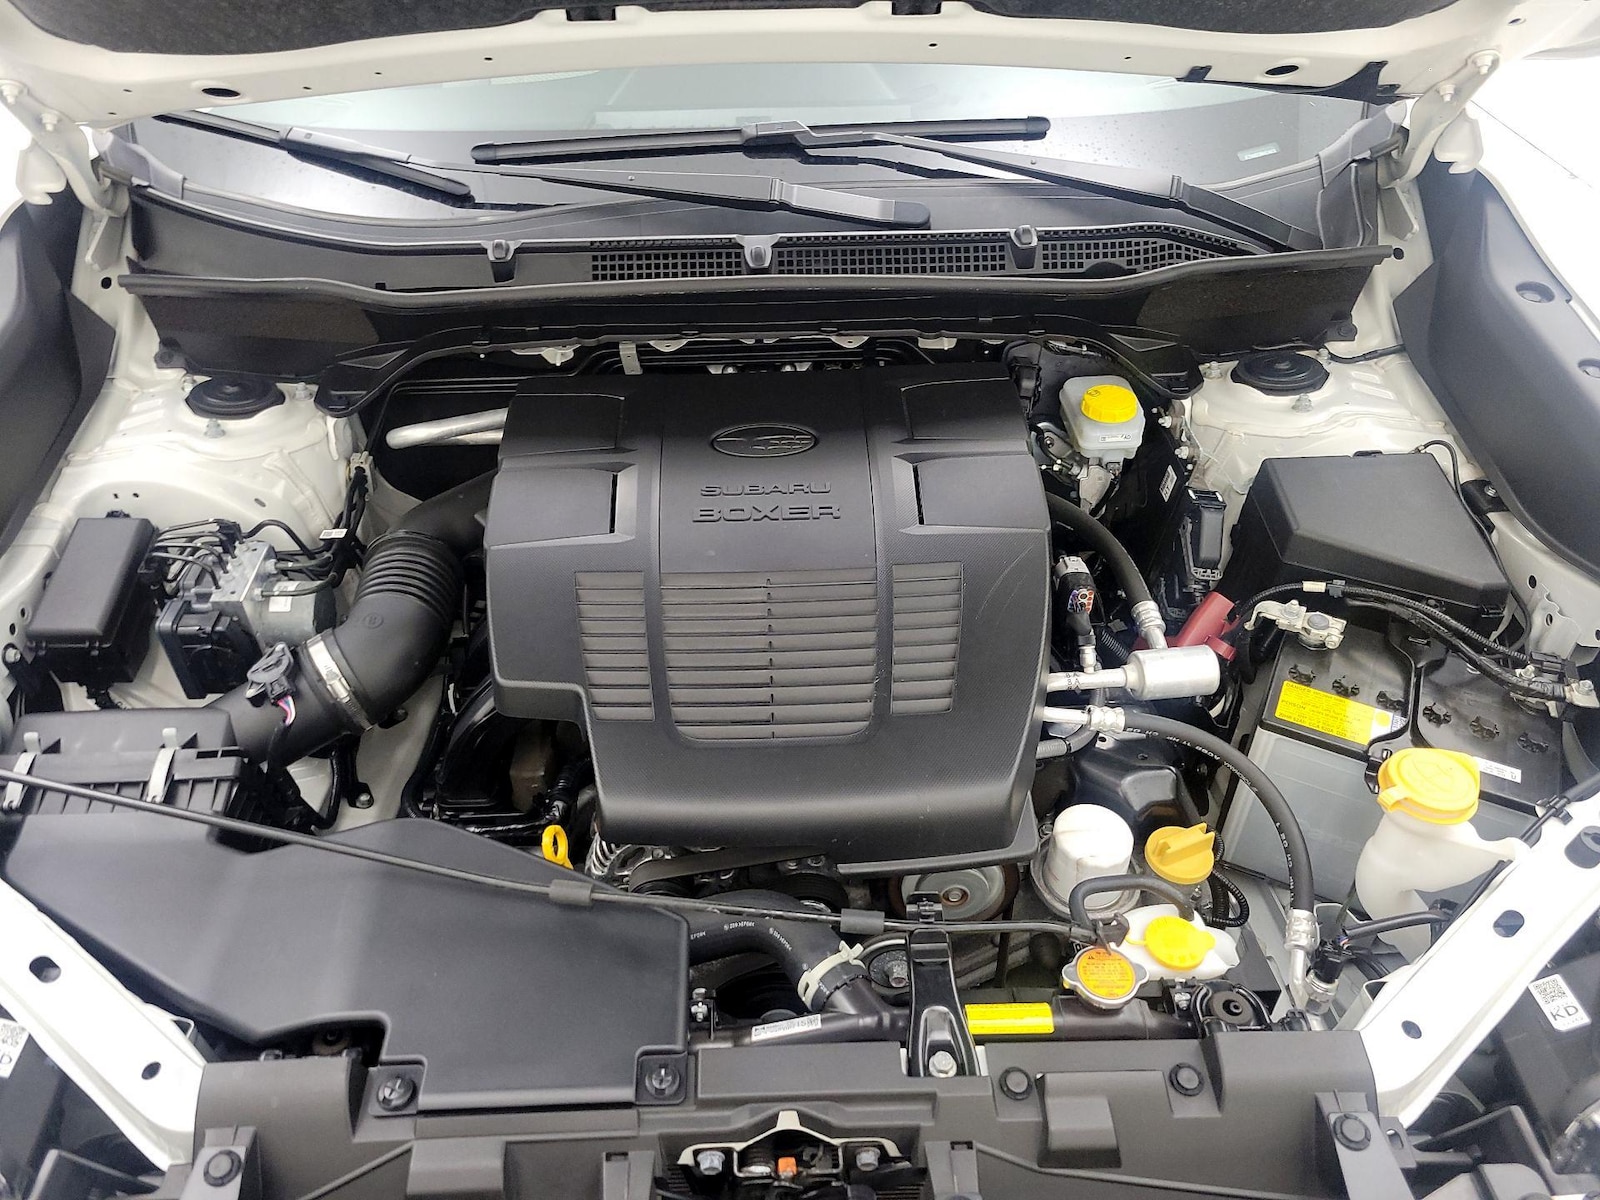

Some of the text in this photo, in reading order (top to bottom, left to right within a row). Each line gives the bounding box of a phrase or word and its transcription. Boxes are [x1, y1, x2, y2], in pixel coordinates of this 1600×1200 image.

[700, 481, 832, 497] SUBARU
[692, 504, 841, 522] BOXER
[1223, 761, 1252, 786] YOKOHAMA
[1550, 1005, 1578, 1021] KD
